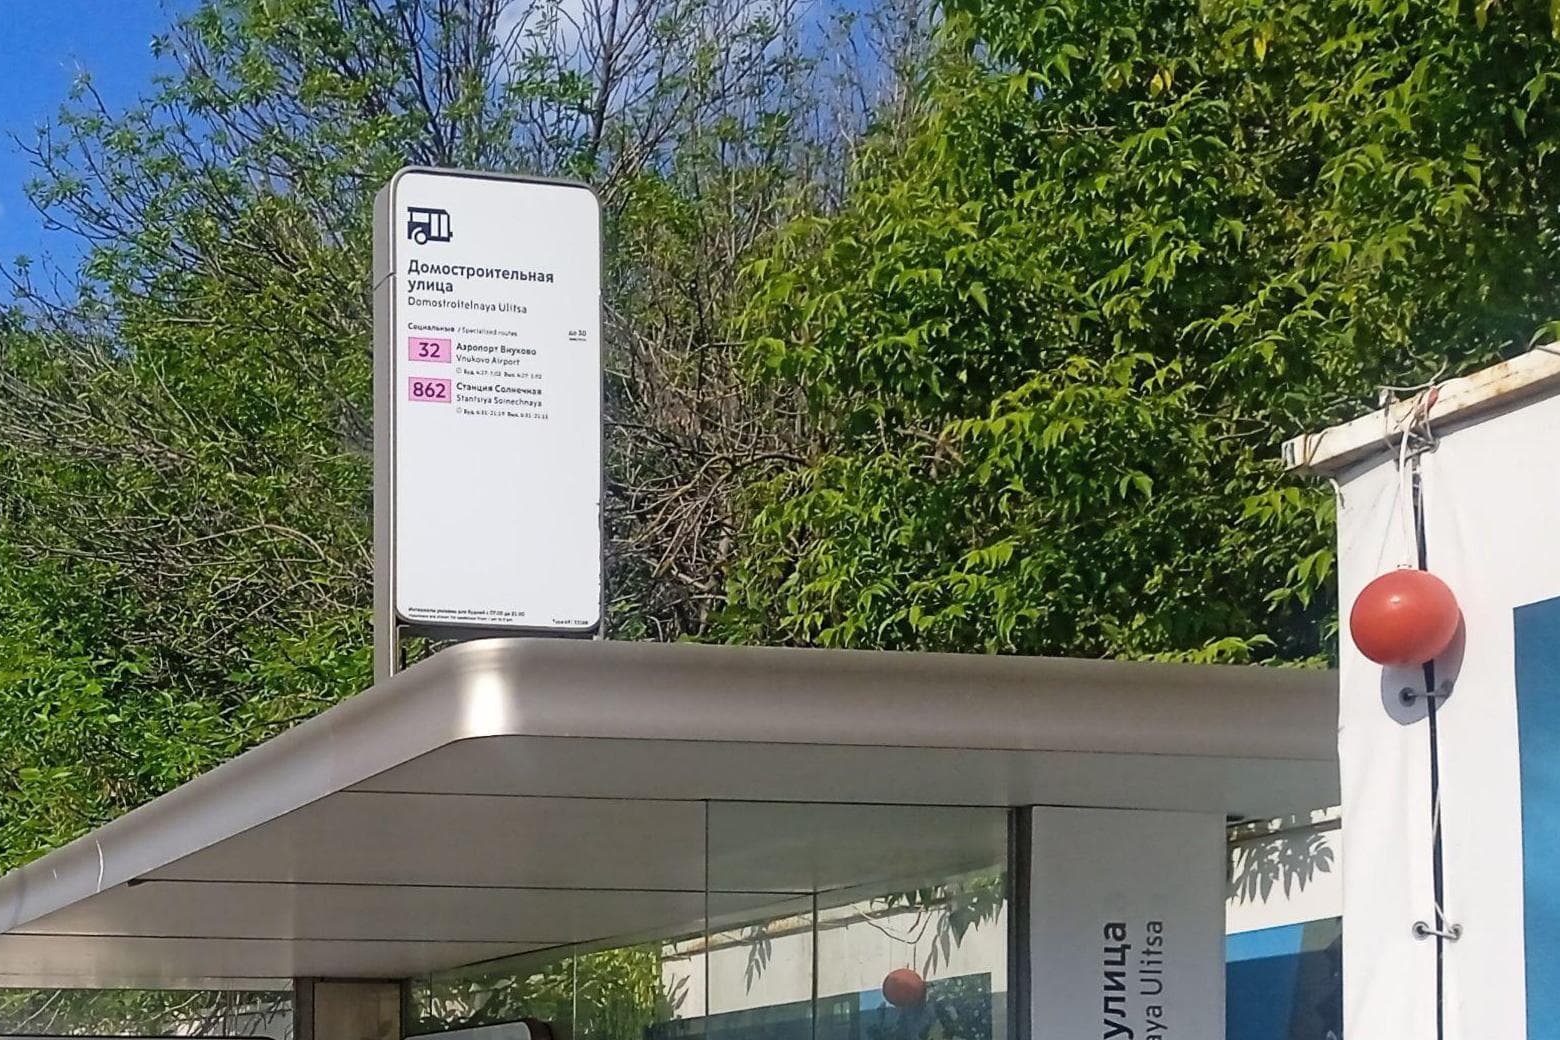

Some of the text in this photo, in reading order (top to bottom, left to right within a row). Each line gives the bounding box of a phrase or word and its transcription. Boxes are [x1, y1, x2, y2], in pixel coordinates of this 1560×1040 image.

[407, 259, 555, 284] Домостроительная
[407, 279, 454, 294] улица
[407, 296, 528, 314] Domostroitelnaya Ulitsa
[418, 342, 441, 358] 32
[456, 343, 537, 357] Аэропорт Внуково
[456, 354, 520, 366] Vnukovo Airport
[412, 381, 446, 399] 862
[456, 382, 542, 396] Станция Солнечная
[456, 394, 492, 404] Stantsiya
[1139, 921, 1163, 995] Ulitsa
[1103, 922, 1134, 1040] улица
